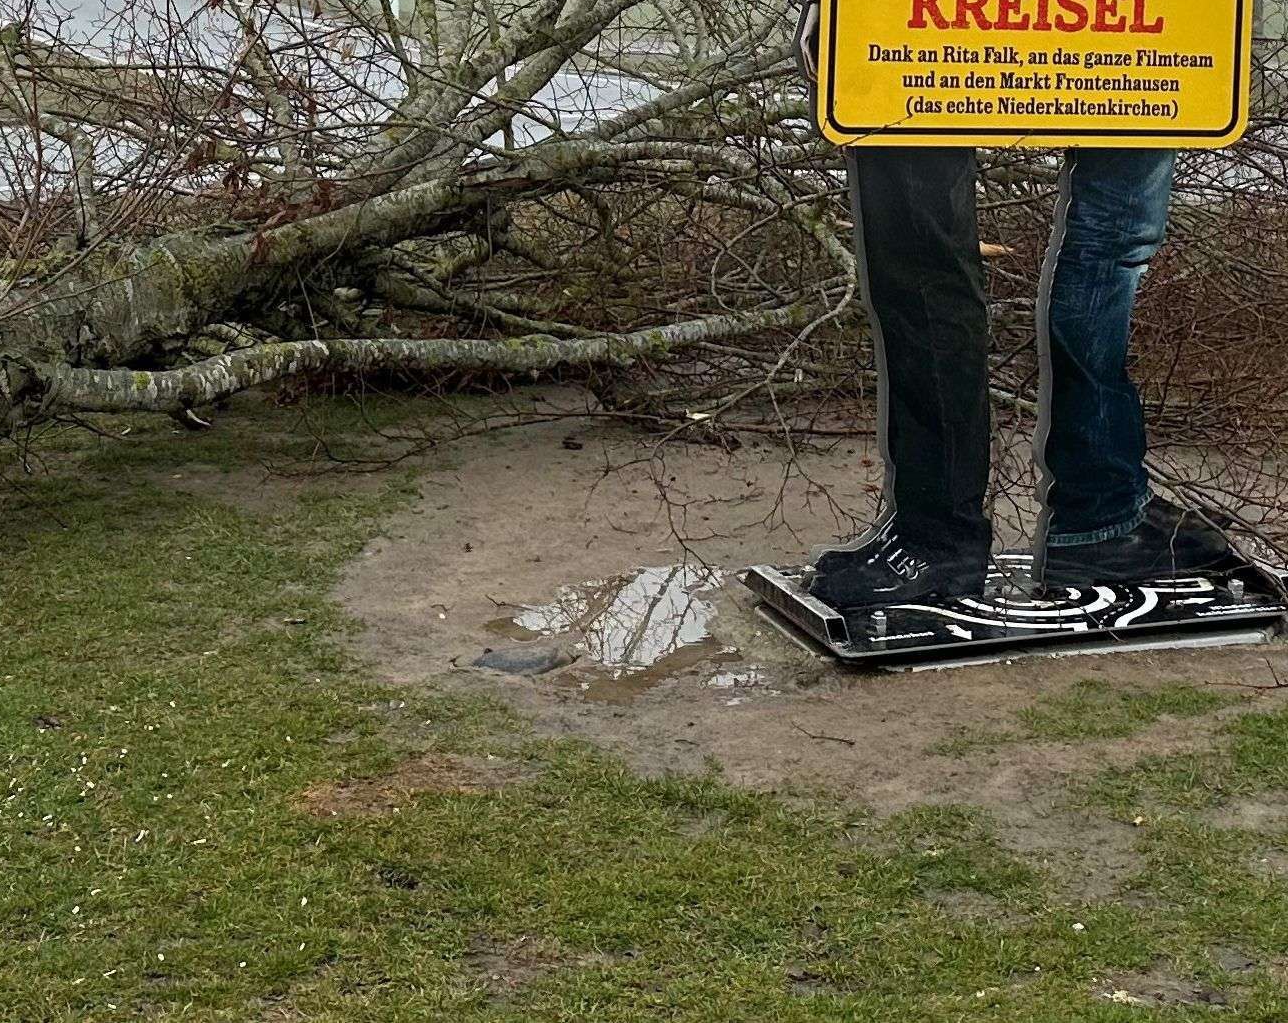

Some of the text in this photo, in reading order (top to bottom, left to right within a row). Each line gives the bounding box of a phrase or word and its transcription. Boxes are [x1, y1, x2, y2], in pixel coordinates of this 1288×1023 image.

[868, 44, 1214, 70] Dank an Rita Falk, an das ganze Filmteam
[902, 70, 1180, 92] und an den Markt Frontenhausen
[905, 95, 1180, 120] (das echte Niederkaltenkirchen)
